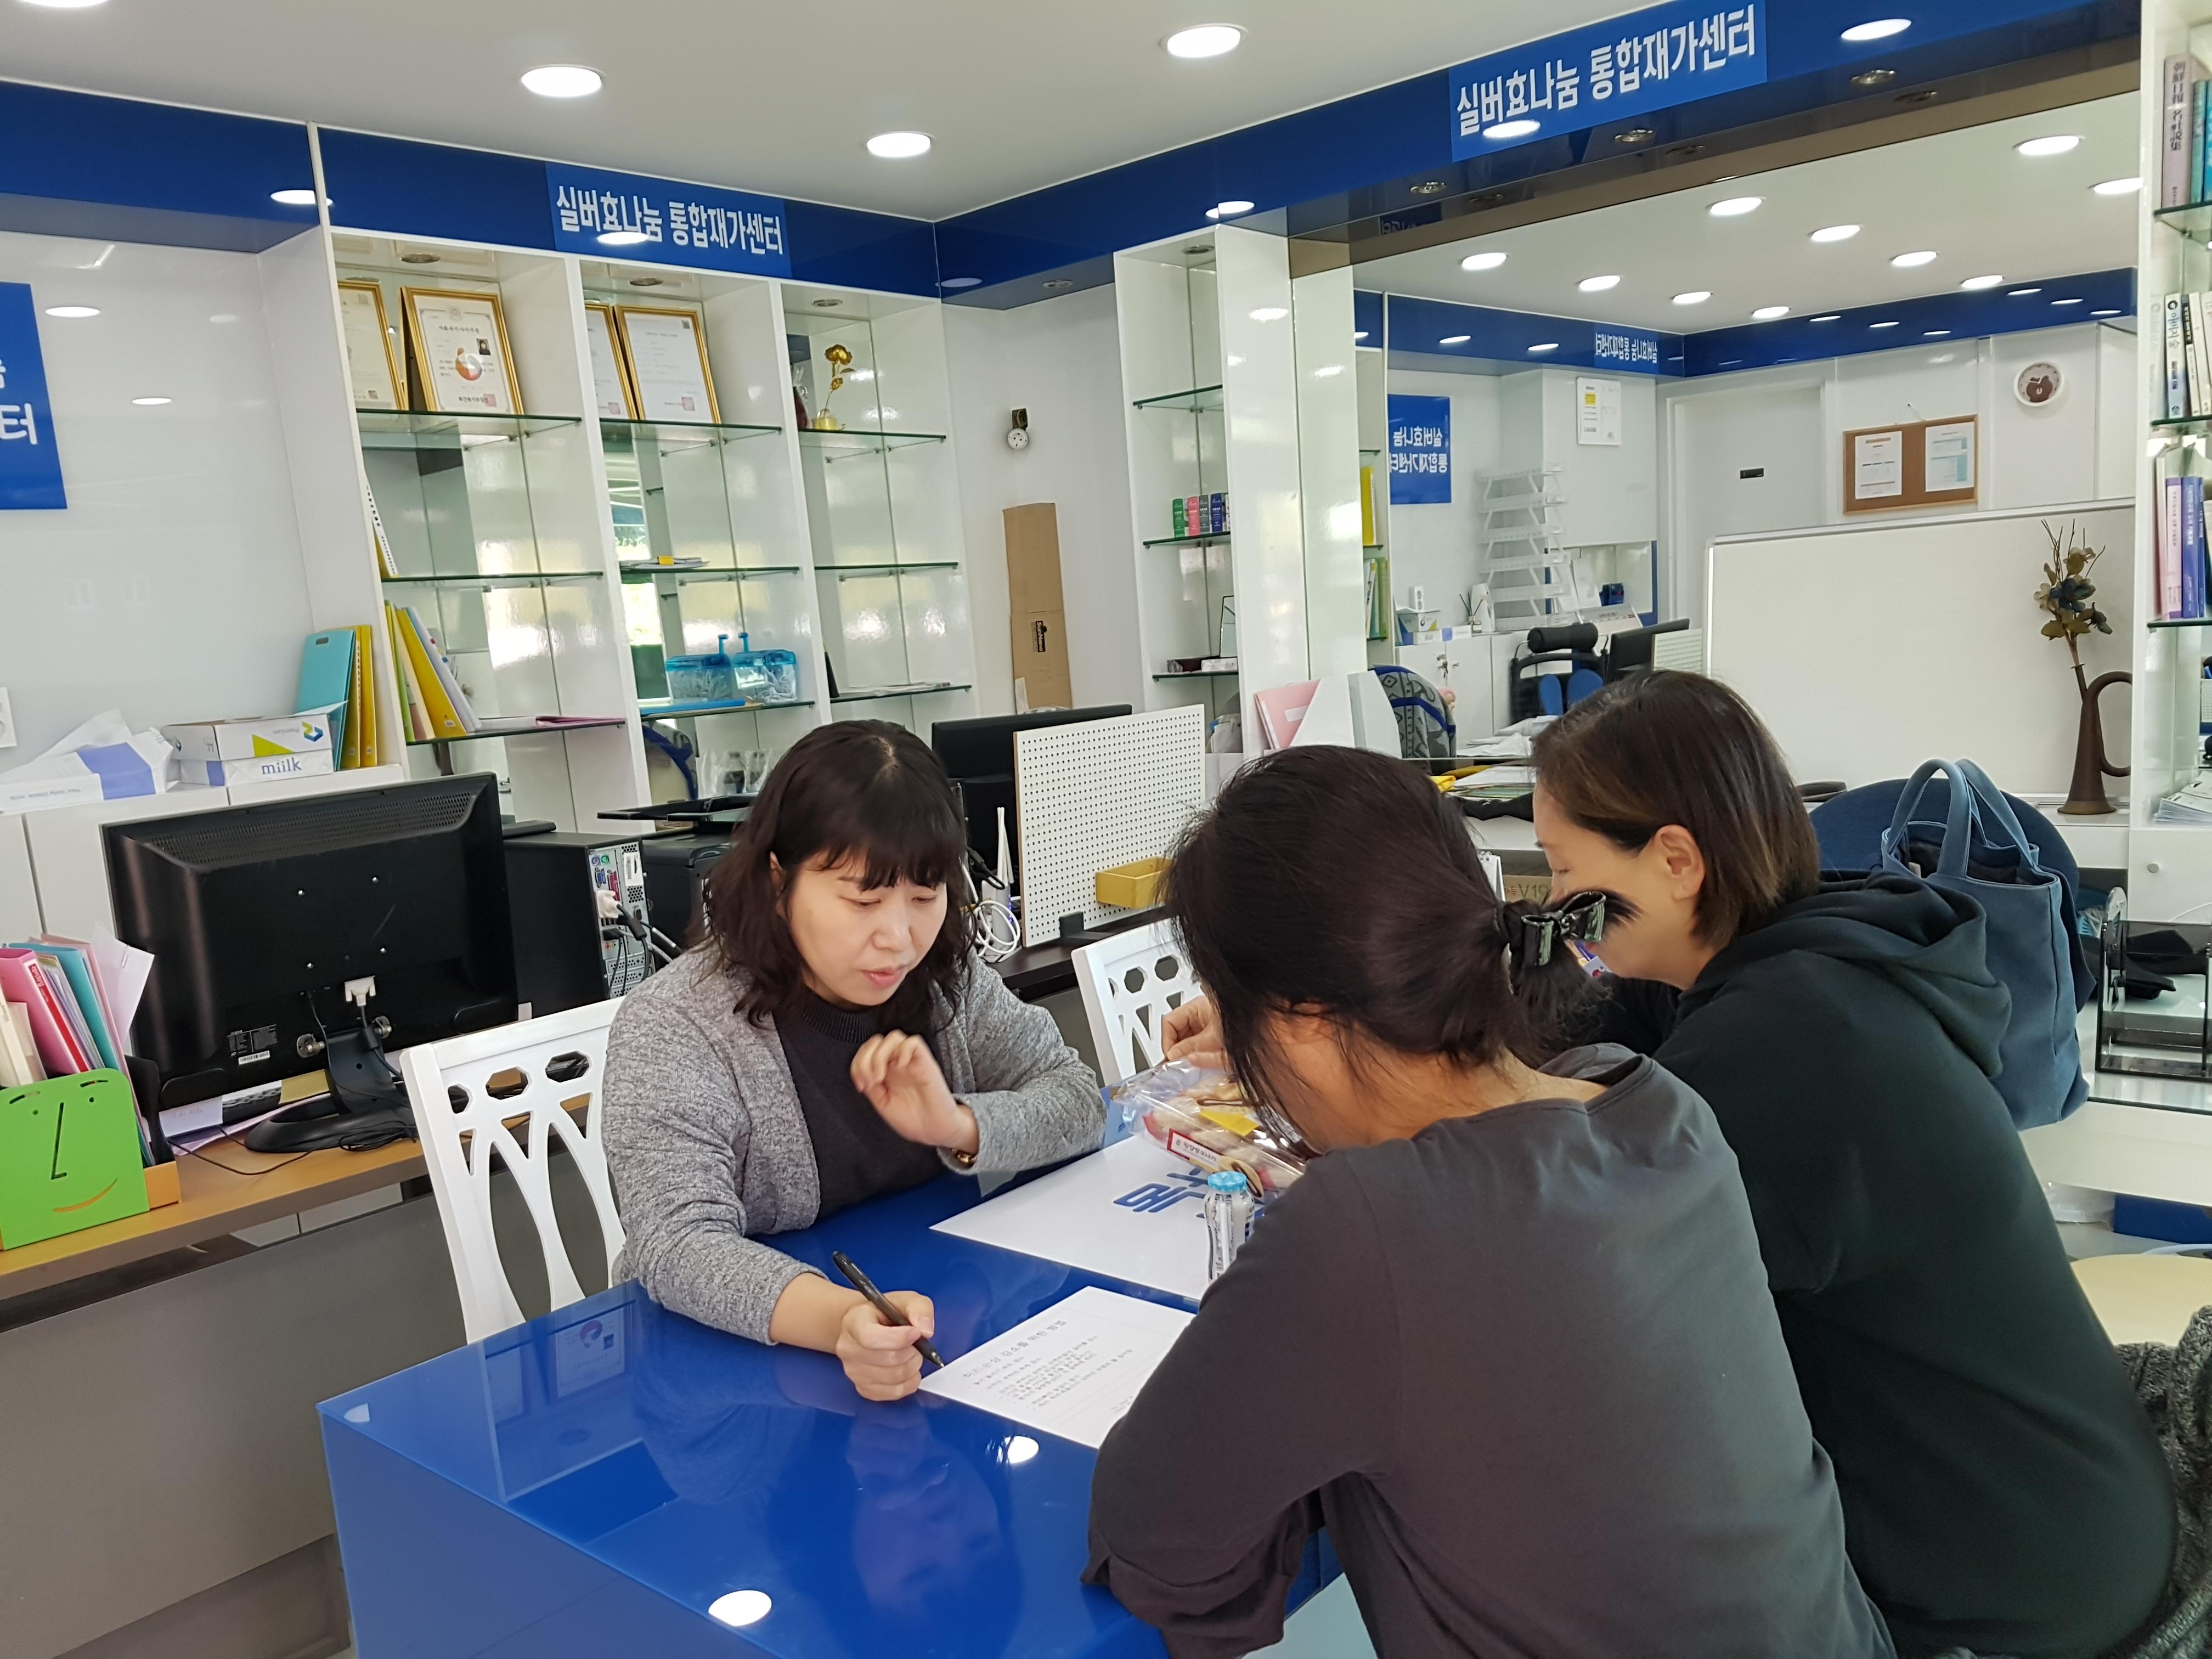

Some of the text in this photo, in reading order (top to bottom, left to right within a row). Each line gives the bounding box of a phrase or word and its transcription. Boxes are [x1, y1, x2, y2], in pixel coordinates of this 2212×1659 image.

[1457, 3, 1756, 137] 실버효나눔 통합재가센터
[556, 185, 784, 255] 실버효나눔 통합재가센터
[272, 727, 300, 735] Premium
[261, 757, 303, 775] miilk
